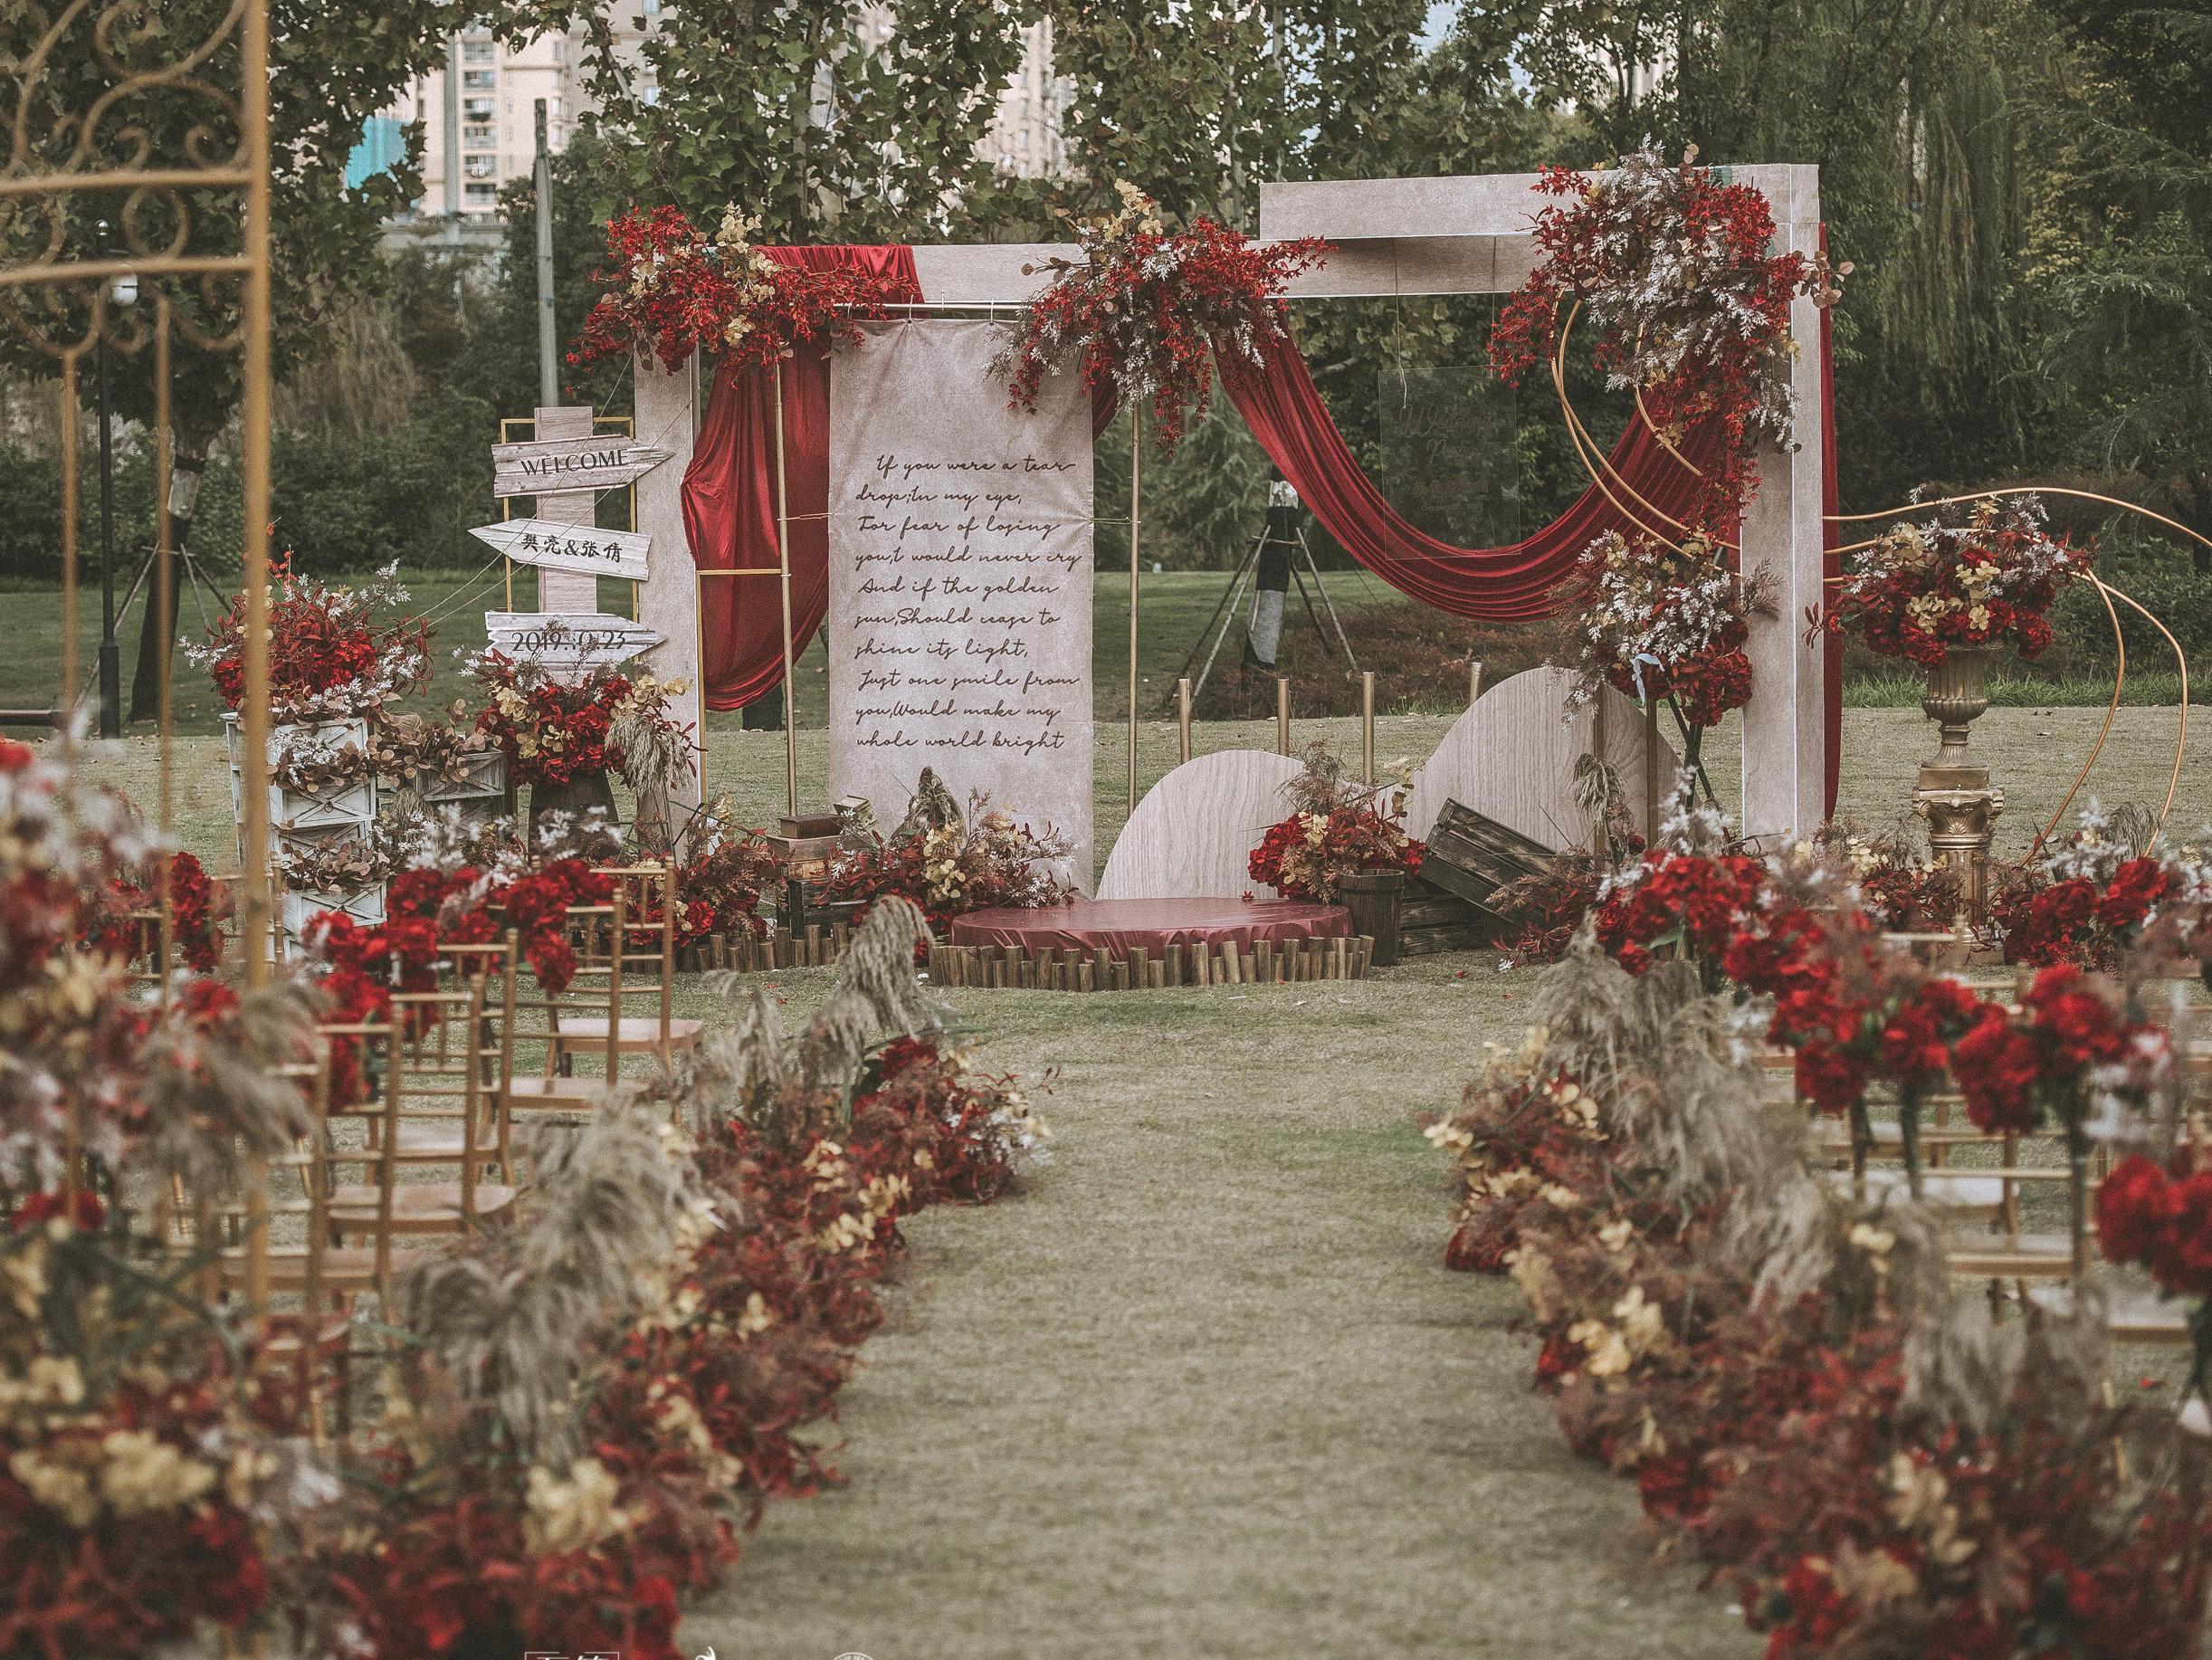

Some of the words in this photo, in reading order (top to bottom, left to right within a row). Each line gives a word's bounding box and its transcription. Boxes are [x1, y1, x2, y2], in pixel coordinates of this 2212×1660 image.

[520, 448, 630, 477] WELCOME
[876, 454, 899, 480] If
[903, 463, 941, 481] you
[947, 461, 996, 471] were
[1001, 463, 1018, 471] a
[1023, 454, 1076, 472] tear
[944, 493, 979, 512] my
[985, 493, 1022, 511] eye,
[857, 515, 897, 532] For
[899, 515, 950, 540] fear
[957, 515, 979, 540] of
[986, 514, 1061, 541] losing
[911, 544, 973, 563] would
[978, 552, 1041, 563] never
[1046, 552, 1082, 573] cry
[857, 575, 906, 594] And
[911, 577, 937, 602] if
[941, 576, 979, 595] the
[982, 575, 1060, 603] golden
[853, 606, 974, 630] sun,Should
[979, 615, 1034, 630] cease
[1038, 607, 1062, 626] to
[853, 637, 921, 660] shine
[926, 637, 959, 661] its
[965, 637, 1028, 662] light,
[857, 668, 901, 692] Just
[908, 677, 948, 685] one
[950, 668, 1019, 692] smile
[1022, 670, 1081, 695] from
[855, 698, 958, 726] you,Would
[963, 699, 1021, 718] make
[1026, 709, 1062, 727] my
[856, 730, 919, 748] whole
[925, 730, 987, 748] world
[992, 730, 1065, 757] bright
